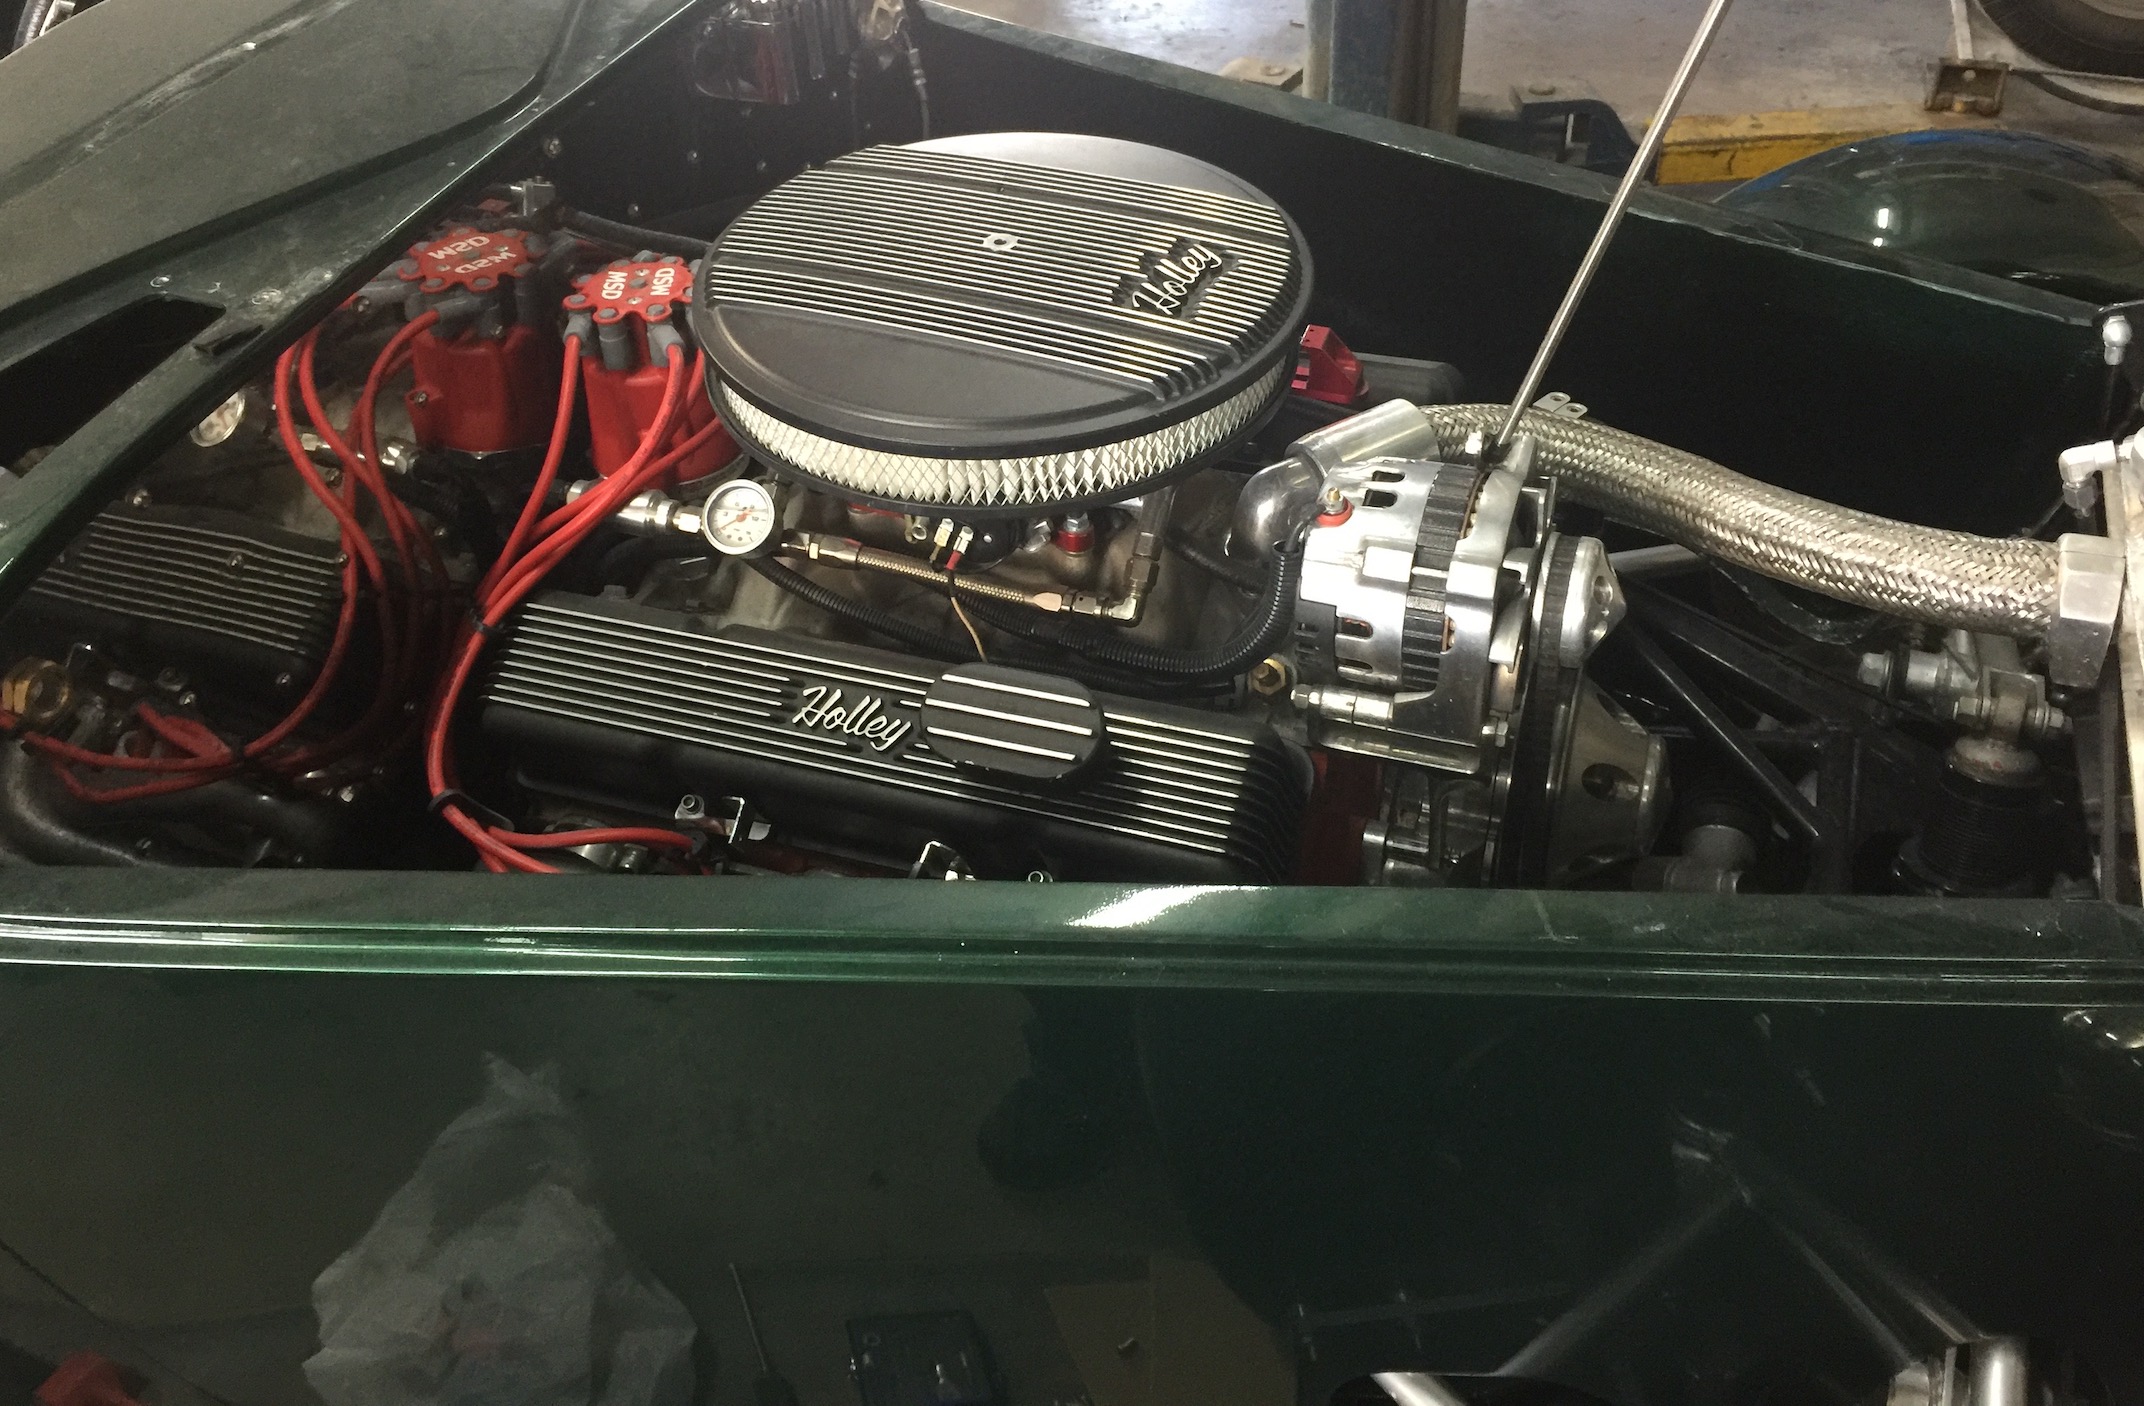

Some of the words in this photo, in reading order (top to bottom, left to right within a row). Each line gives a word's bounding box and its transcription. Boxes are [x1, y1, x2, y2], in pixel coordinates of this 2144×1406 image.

[601, 270, 629, 300] MSD
[649, 267, 676, 296] MSD
[1131, 243, 1223, 316] Holley
[791, 685, 912, 752] Holley
